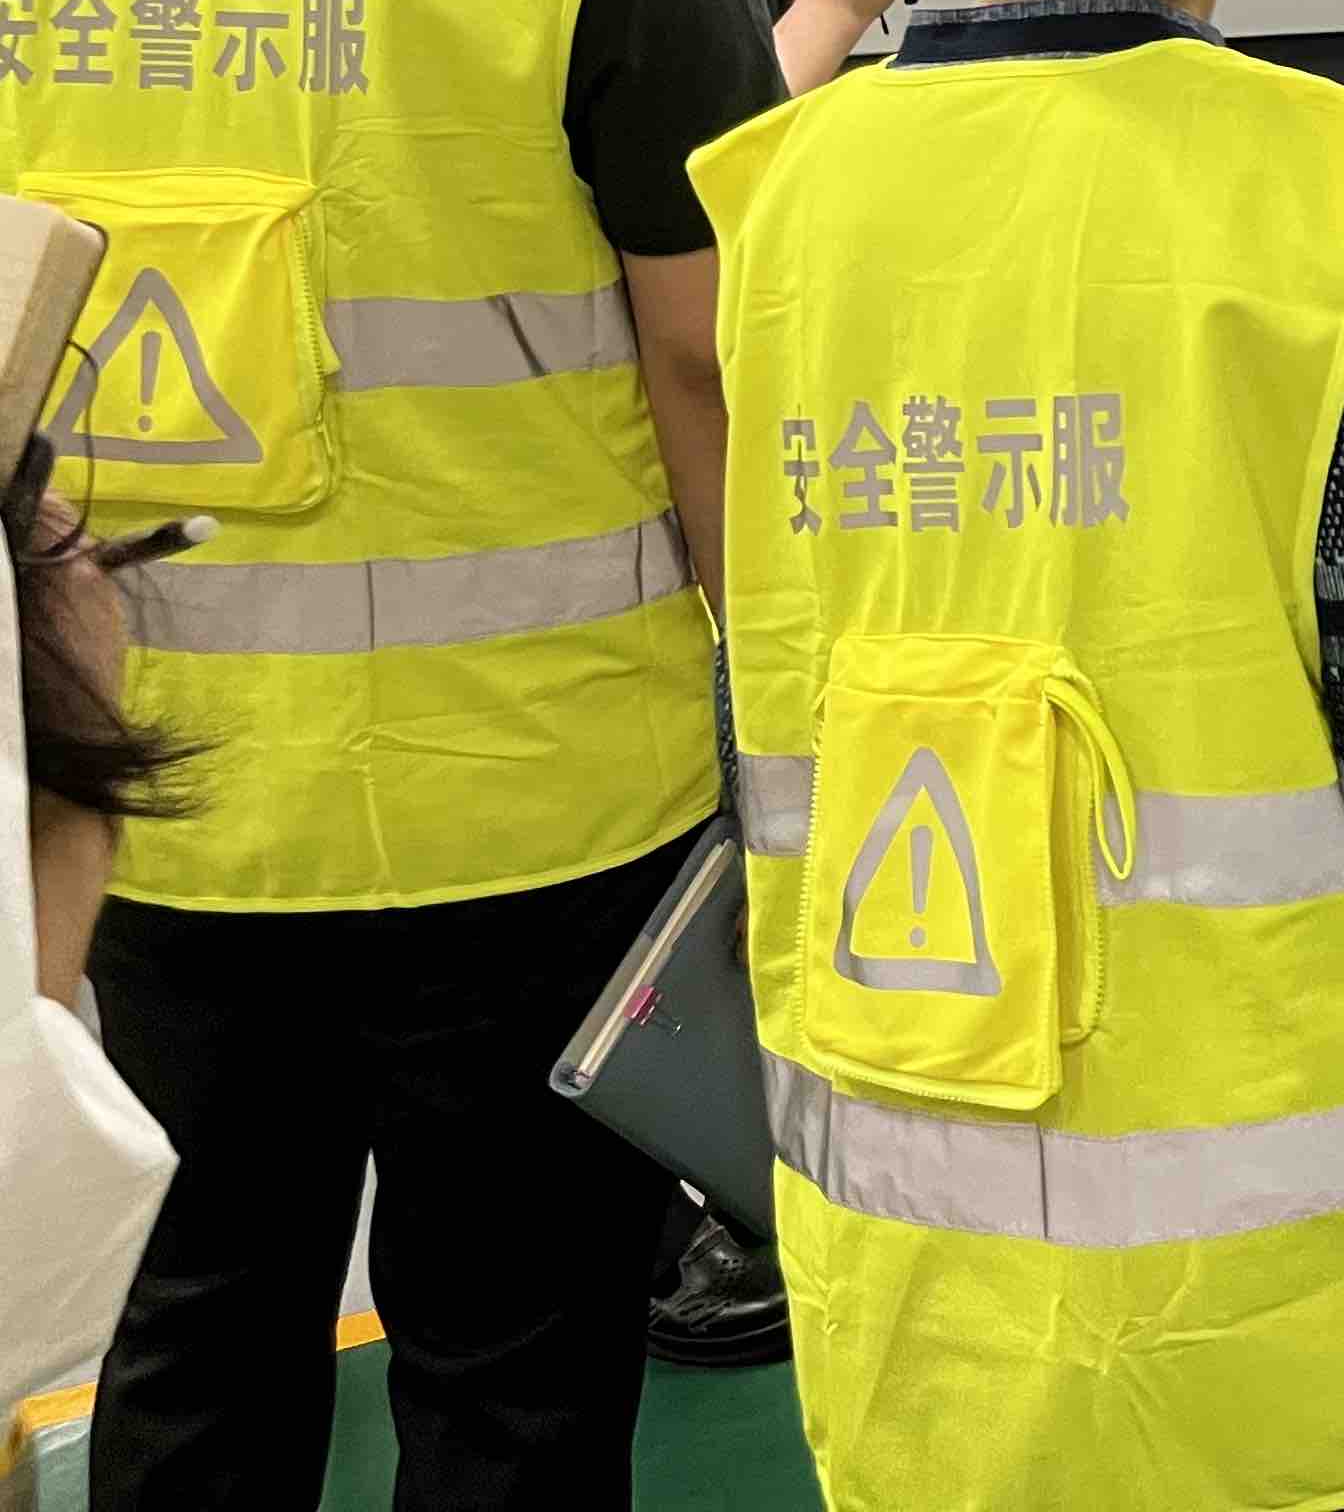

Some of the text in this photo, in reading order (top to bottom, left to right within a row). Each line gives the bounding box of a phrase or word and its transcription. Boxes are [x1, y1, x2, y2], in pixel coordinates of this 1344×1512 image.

[782, 393, 1131, 536] 安全警示服
